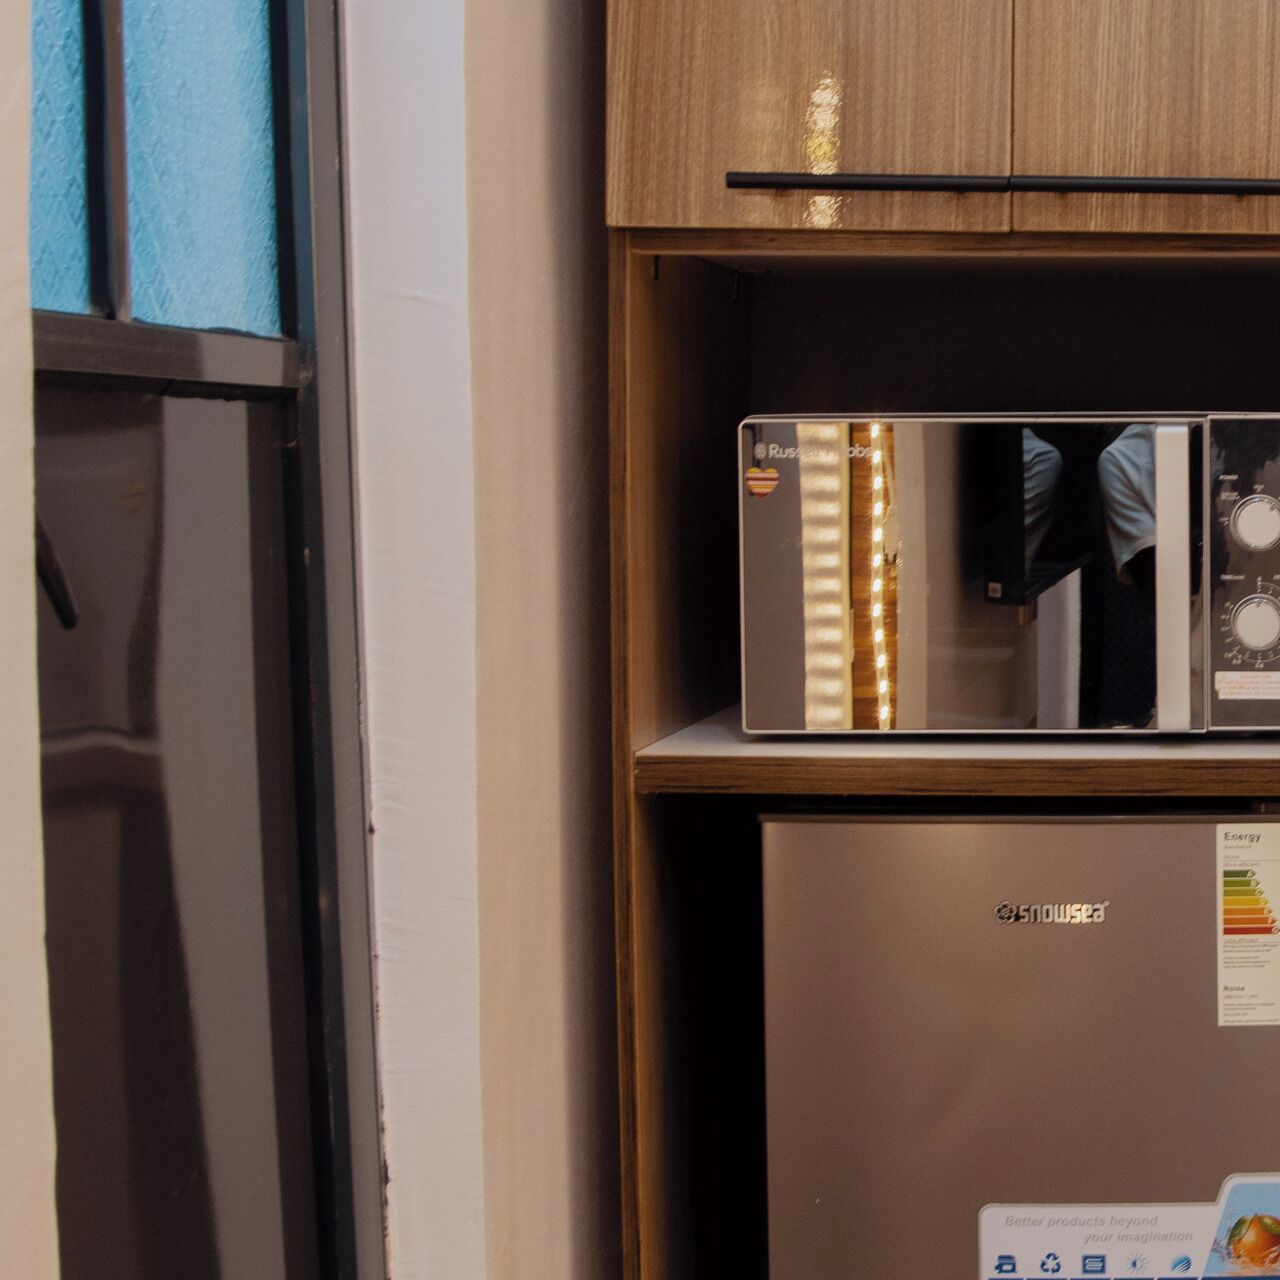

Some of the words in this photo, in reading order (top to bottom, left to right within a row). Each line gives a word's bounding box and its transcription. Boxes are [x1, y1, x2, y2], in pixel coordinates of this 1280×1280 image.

[768, 443, 819, 458] Russ
[1223, 831, 1262, 843] Energy
[1005, 1215, 1043, 1227] Better
[1047, 1215, 1105, 1229] products
[1109, 1215, 1158, 1229] beyond
[1084, 1233, 1113, 1245] your
[1117, 1231, 1193, 1244] imagination
